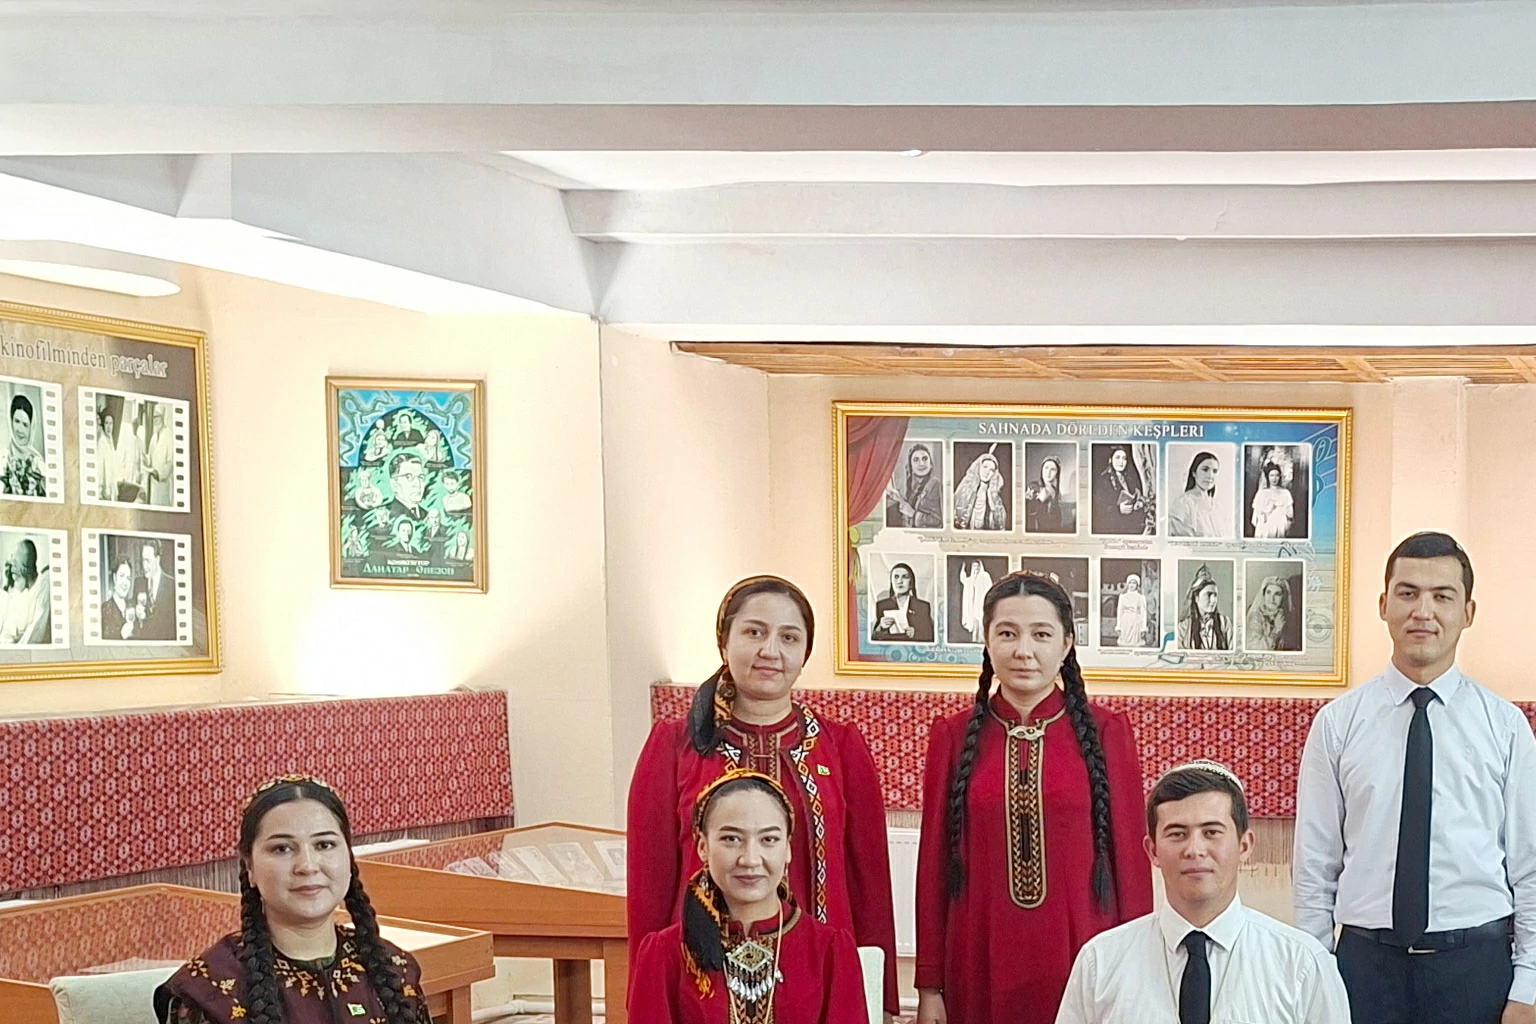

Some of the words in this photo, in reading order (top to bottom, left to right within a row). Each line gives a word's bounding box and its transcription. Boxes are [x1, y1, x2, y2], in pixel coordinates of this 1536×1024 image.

[0, 334, 107, 369] kinofilminden
[110, 353, 169, 379] parçalar
[978, 422, 1050, 436] SAHNADA
[1056, 421, 1128, 438] DÖREDEN
[1132, 424, 1204, 440] KEŞPLERI
